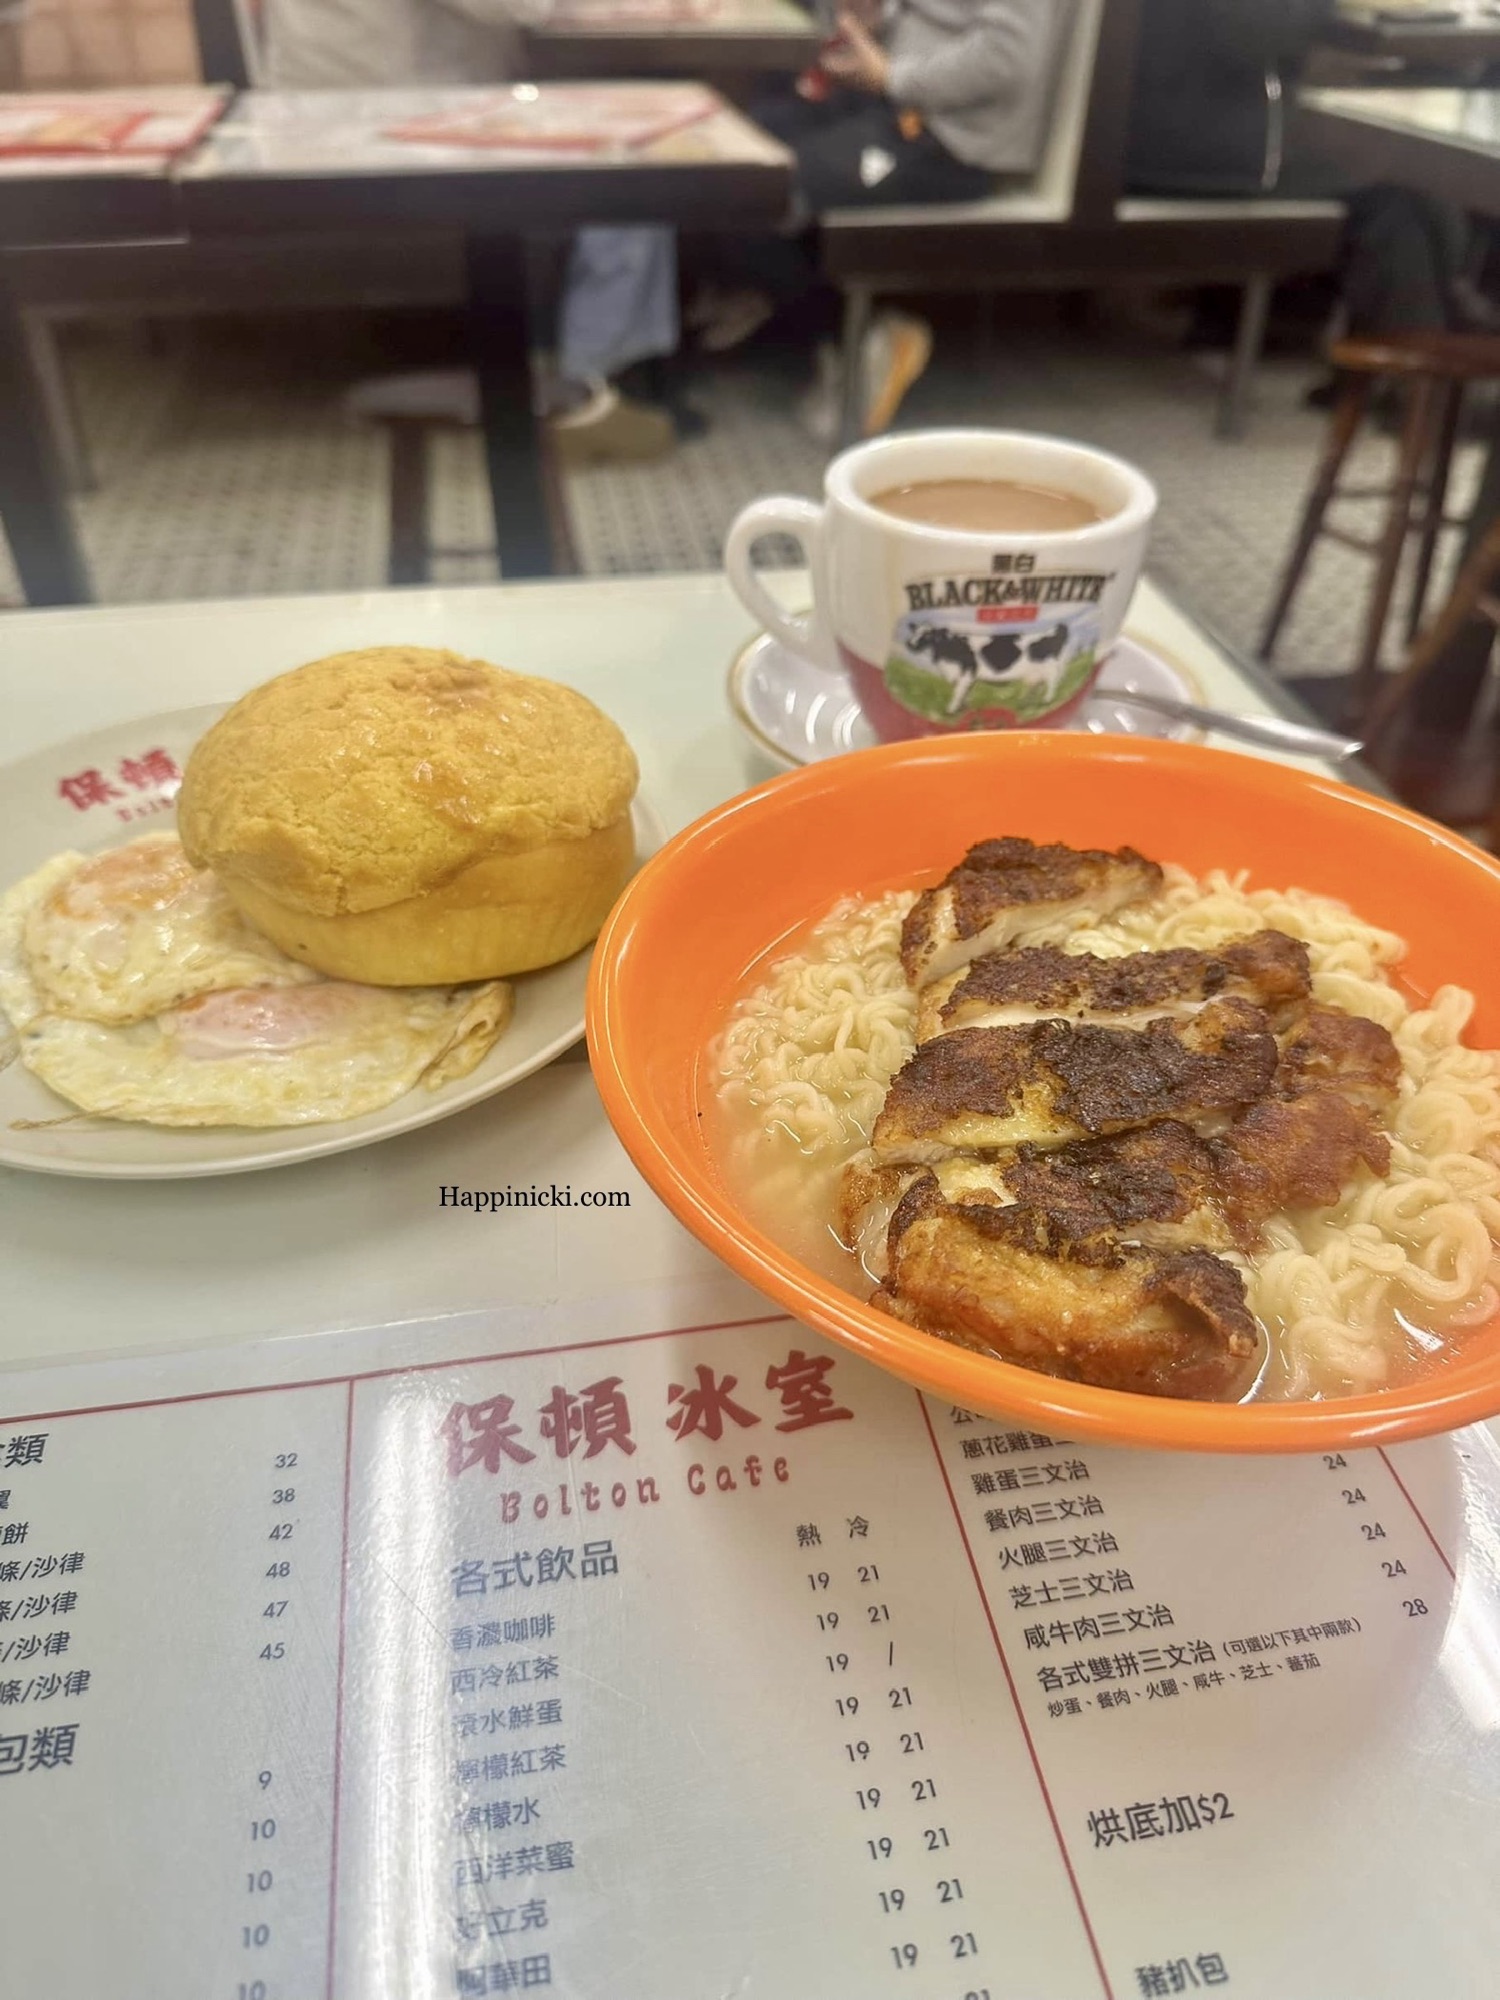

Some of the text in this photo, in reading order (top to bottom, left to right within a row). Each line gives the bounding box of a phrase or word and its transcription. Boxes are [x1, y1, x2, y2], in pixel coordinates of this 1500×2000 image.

[0, 1433, 50, 1468] 類
[274, 1453, 298, 1469] 32
[1323, 1453, 1347, 1470] 24
[500, 1455, 790, 1523] Bolton Cafe
[970, 1459, 1090, 1495] 雞蛋三文治
[272, 1487, 296, 1504] 38
[1341, 1487, 1366, 1505] 24
[984, 1494, 1105, 1532] 餐肉三文治
[269, 1523, 294, 1541] 42
[796, 1515, 870, 1548] 熱 冷
[1360, 1522, 1386, 1541] 24
[998, 1530, 1120, 1570] 火腿三文治
[265, 1561, 291, 1578] 48
[451, 1539, 620, 1599] 各式飲品
[808, 1565, 880, 1591] 19 21
[1381, 1559, 1407, 1578] 24
[1008, 1568, 1135, 1611] 芝士三文治
[263, 1600, 289, 1618] 47
[817, 1604, 890, 1631] 19 21
[1402, 1598, 1429, 1618] 28
[1023, 1603, 1176, 1652] 咸牛肉三文治
[0, 1631, 71, 1663] /沙律
[259, 1642, 286, 1660] 45
[450, 1655, 559, 1695] 西冷紅茶
[826, 1653, 849, 1672] 19
[1036, 1639, 1217, 1693] 各式雙拼三文治
[836, 1687, 913, 1716] 19 21
[845, 1732, 924, 1763] 19 21
[258, 1770, 272, 1790] 9
[856, 1779, 937, 1810] 19 21
[251, 1819, 276, 1841] 10
[1087, 1791, 1235, 1849] 烘底加$2
[867, 1828, 950, 1861] 19 21
[247, 1870, 273, 1893] 10
[878, 1879, 964, 1913] 19 21
[242, 1924, 270, 1948] 10
[890, 1932, 979, 1970] 19 21
[1134, 1951, 1230, 1999] 豬扒包
